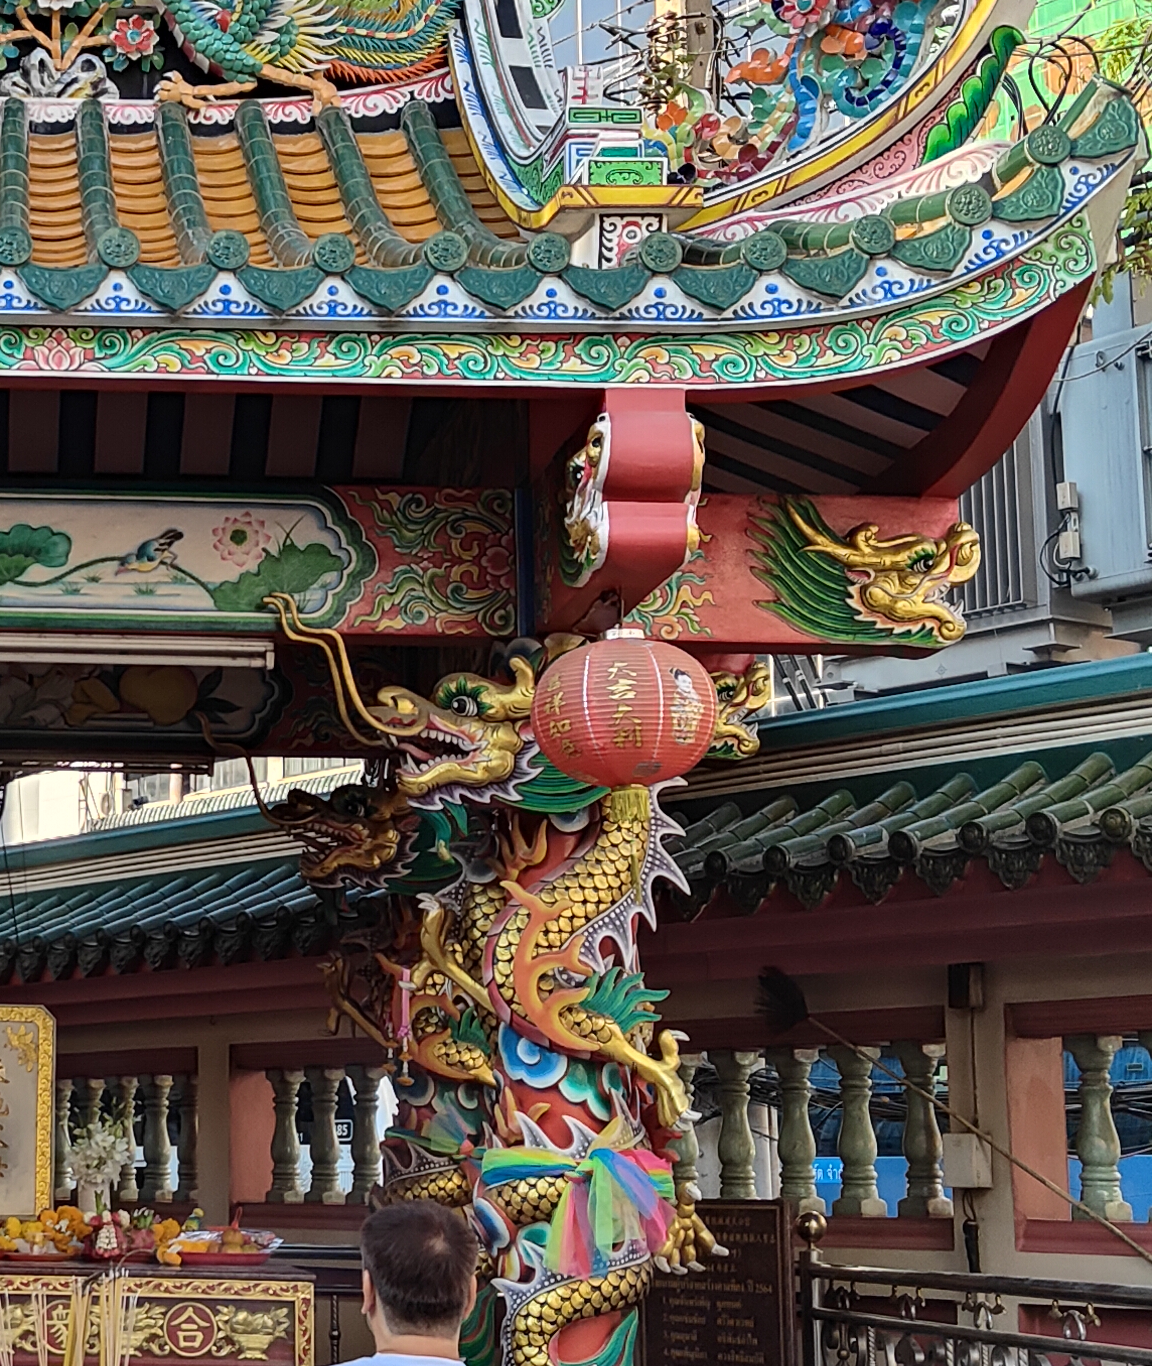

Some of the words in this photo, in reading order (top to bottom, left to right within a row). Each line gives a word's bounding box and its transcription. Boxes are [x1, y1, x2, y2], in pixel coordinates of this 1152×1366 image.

[605, 660, 643, 749] 大吉大利
[170, 1306, 211, 1350] 合
